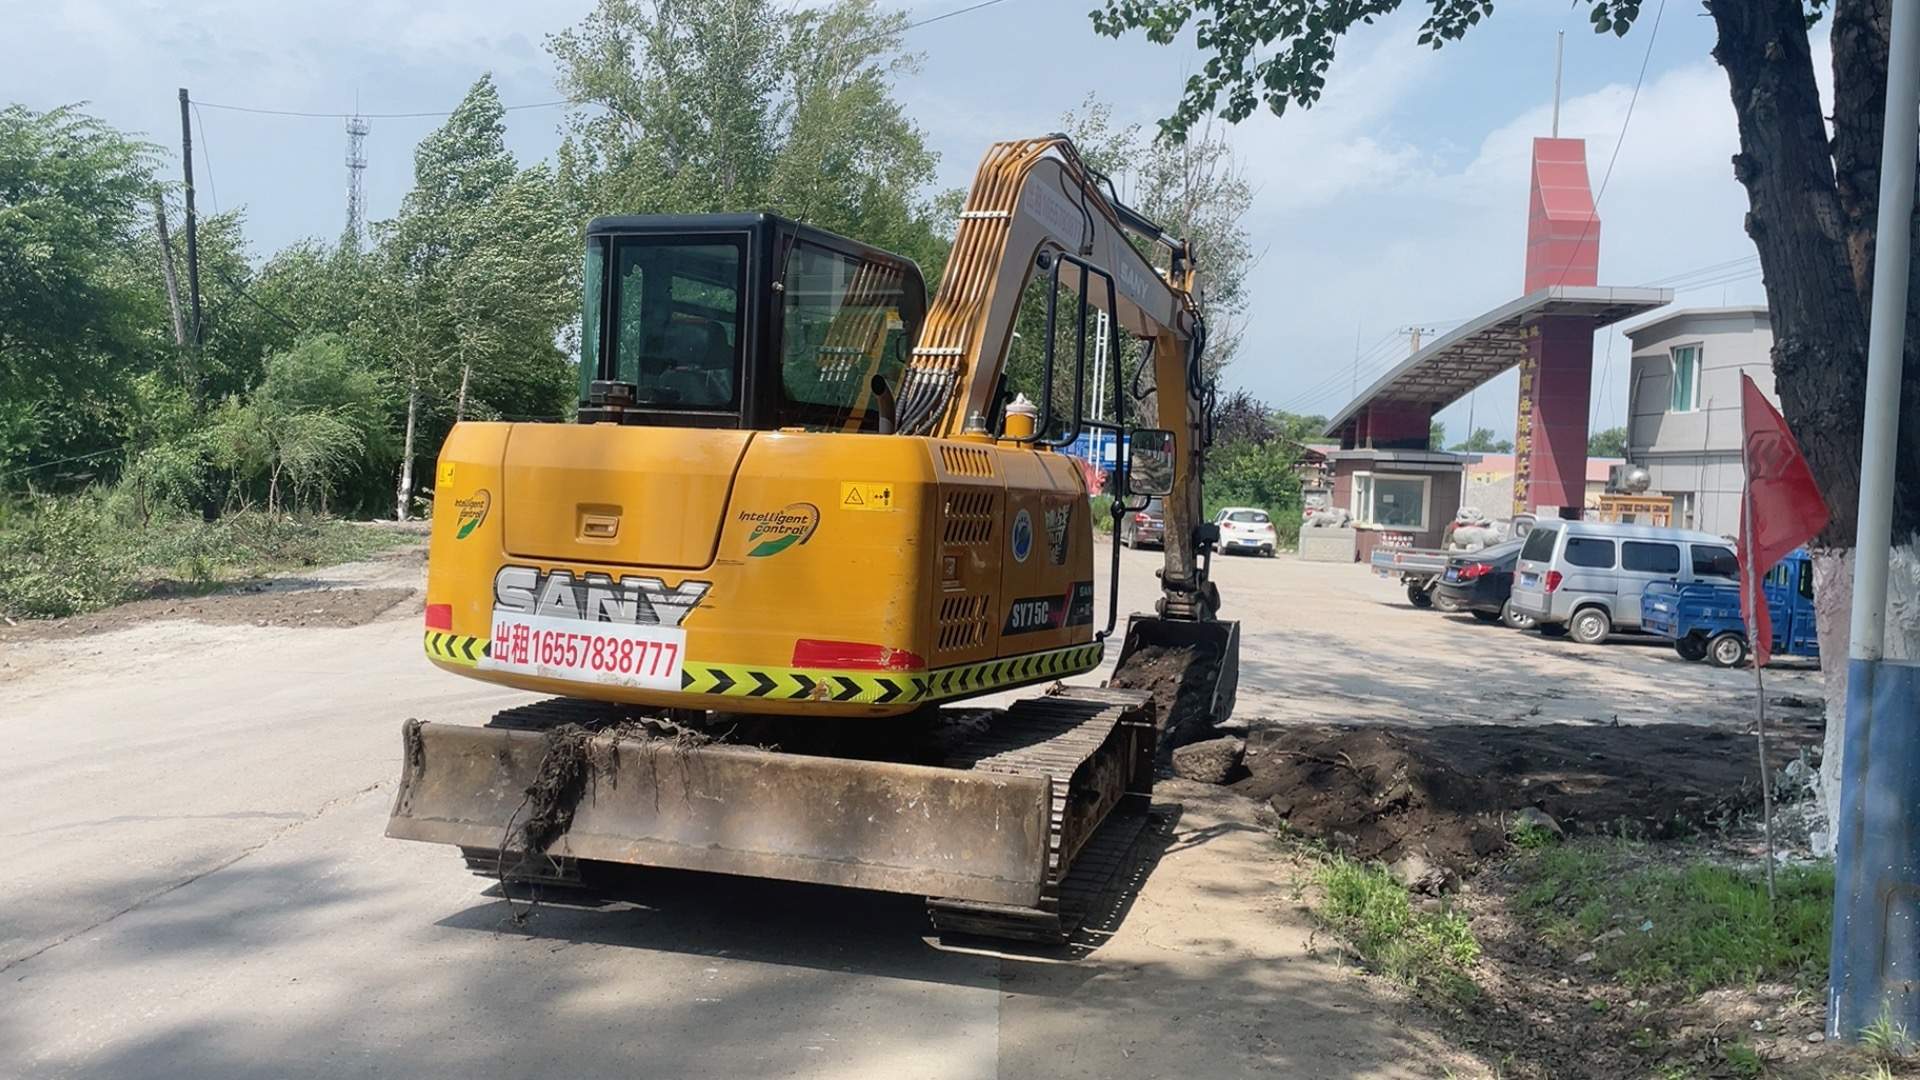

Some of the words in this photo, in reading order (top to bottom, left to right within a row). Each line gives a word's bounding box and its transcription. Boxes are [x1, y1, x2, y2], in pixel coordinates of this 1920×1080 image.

[1120, 262, 1149, 299] SANY
[739, 510, 809, 525] Intelligent
[755, 524, 804, 535] control
[494, 565, 712, 625] SANY
[1011, 600, 1049, 629] SY75C
[494, 621, 678, 677] 出租16557838777
